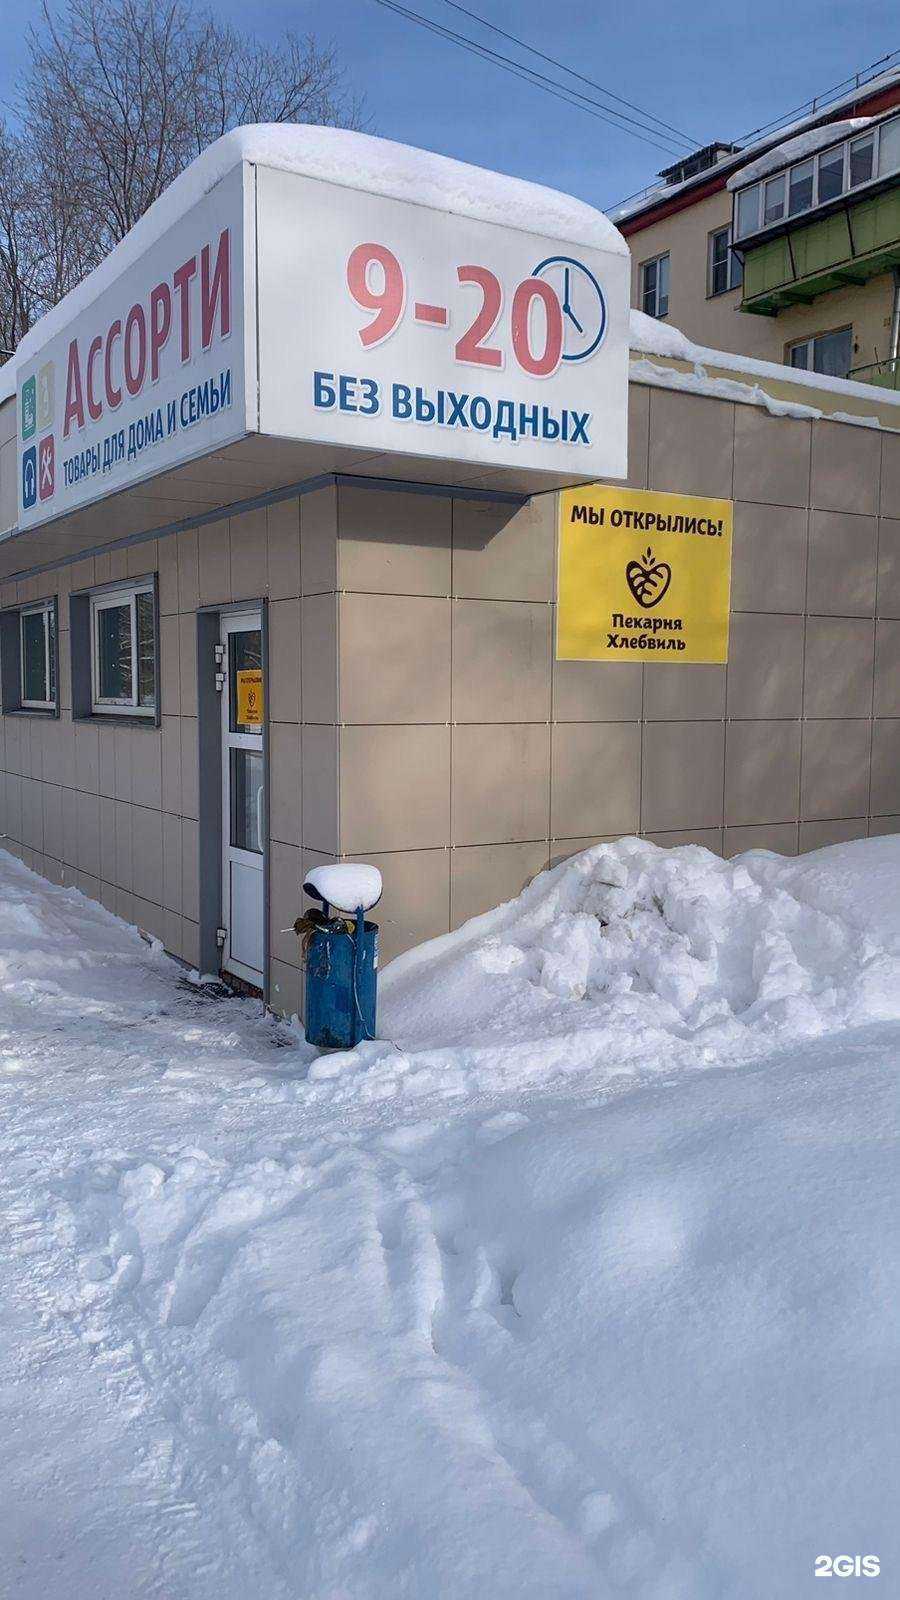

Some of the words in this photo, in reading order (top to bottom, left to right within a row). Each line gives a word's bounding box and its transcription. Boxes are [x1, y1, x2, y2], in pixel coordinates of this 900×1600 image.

[63, 226, 231, 439] АССОРТИ
[346, 242, 564, 376] 9-20
[63, 444, 101, 487] ТОВАРЫ
[102, 439, 125, 473] ДЛЯ
[128, 412, 164, 460] ДОМА
[167, 402, 177, 433] И
[180, 369, 231, 427] СЕМЬИ
[313, 371, 380, 415] БЕЗ
[392, 383, 591, 444] ВЫХОДНЫХ
[571, 505, 605, 526] МЫ
[610, 509, 724, 537] ОТКРЫЛИСЬ!
[607, 634, 686, 651] Хлебвиль
[612, 613, 683, 633] Пекарня
